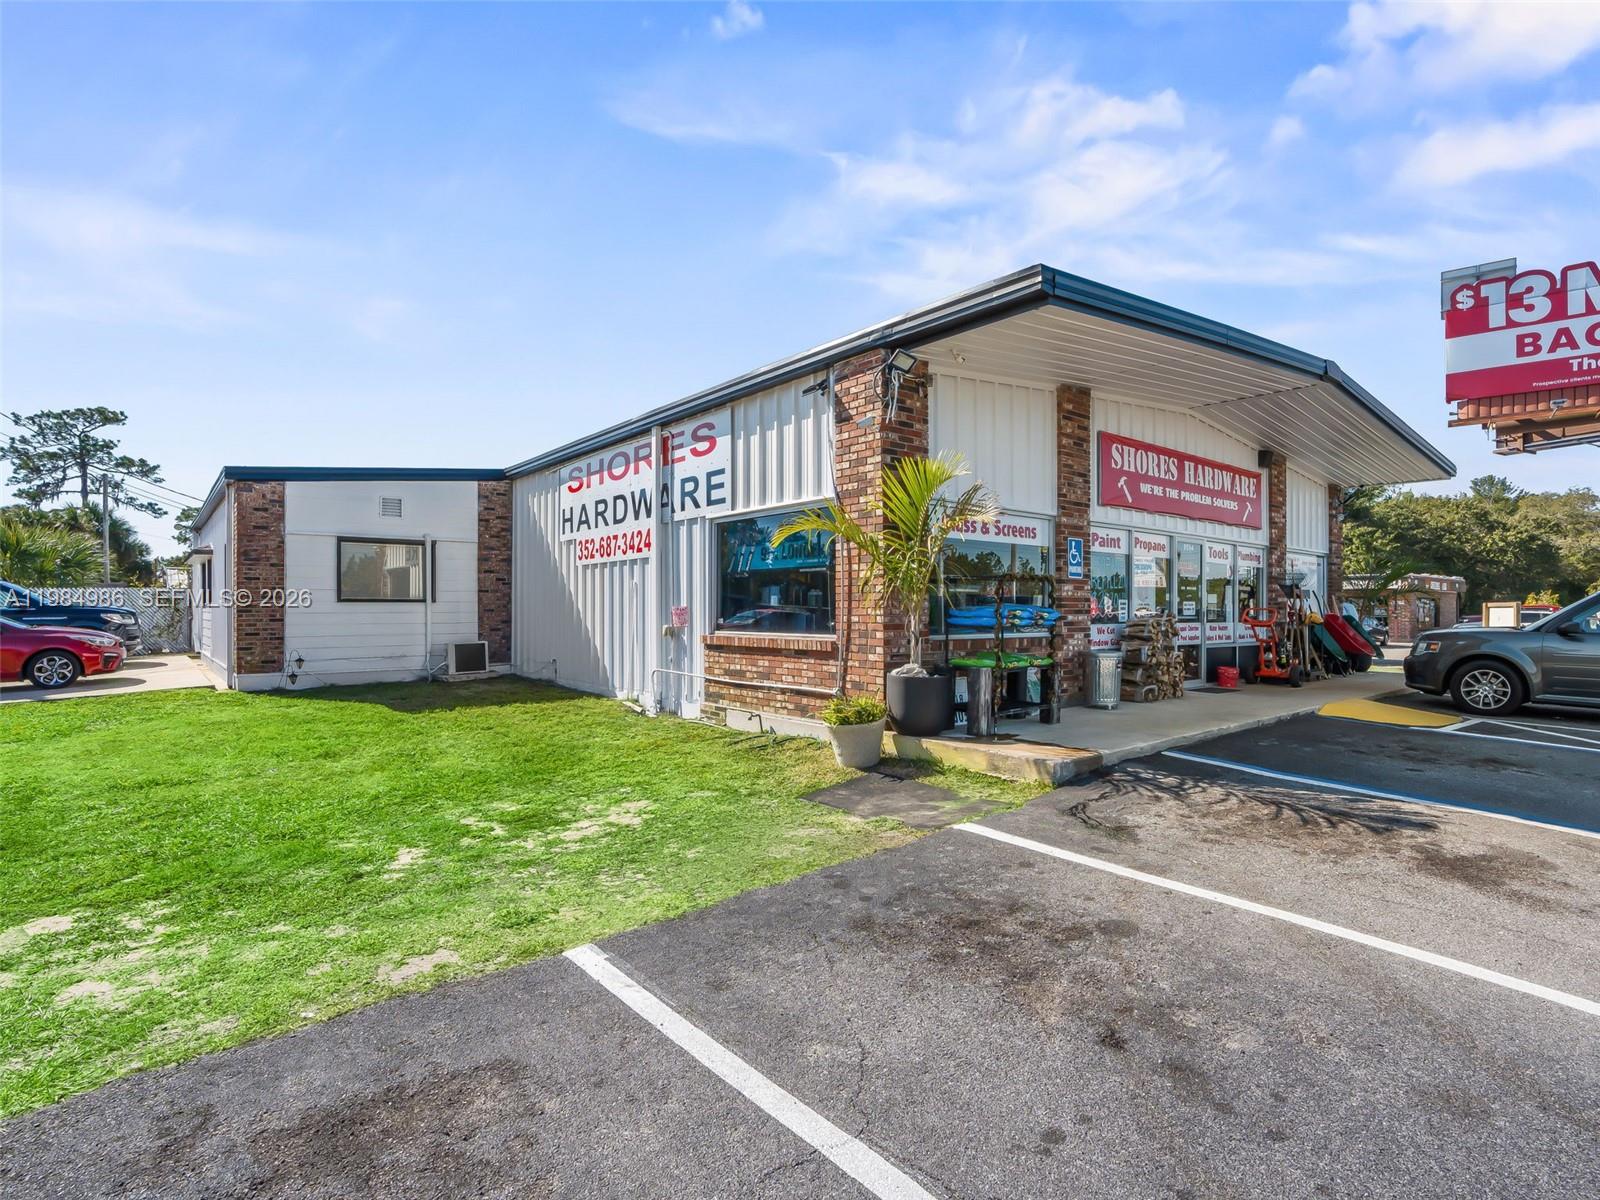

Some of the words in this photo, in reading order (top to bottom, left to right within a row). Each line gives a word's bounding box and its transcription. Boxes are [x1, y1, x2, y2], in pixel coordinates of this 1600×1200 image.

[1455, 274, 1552, 329] $13
[1568, 357, 1600, 371] Th
[567, 422, 717, 494] SHORES
[1111, 443, 1178, 481] SHORES
[1184, 461, 1257, 499] HARDWARE
[561, 468, 727, 535] HARDWARE
[1140, 482, 1164, 497] WE'RE
[1165, 487, 1180, 499] THE
[1180, 490, 1212, 506] PROBLEM
[1212, 497, 1239, 511] SOLVERS
[980, 519, 990, 535] &
[994, 519, 1037, 539] Screens
[1091, 532, 1121, 549] Paint
[577, 528, 652, 561] 352-687-3424
[1134, 537, 1166, 553] Propane
[1208, 546, 1229, 560] Tools
[1096, 626, 1106, 635] We
